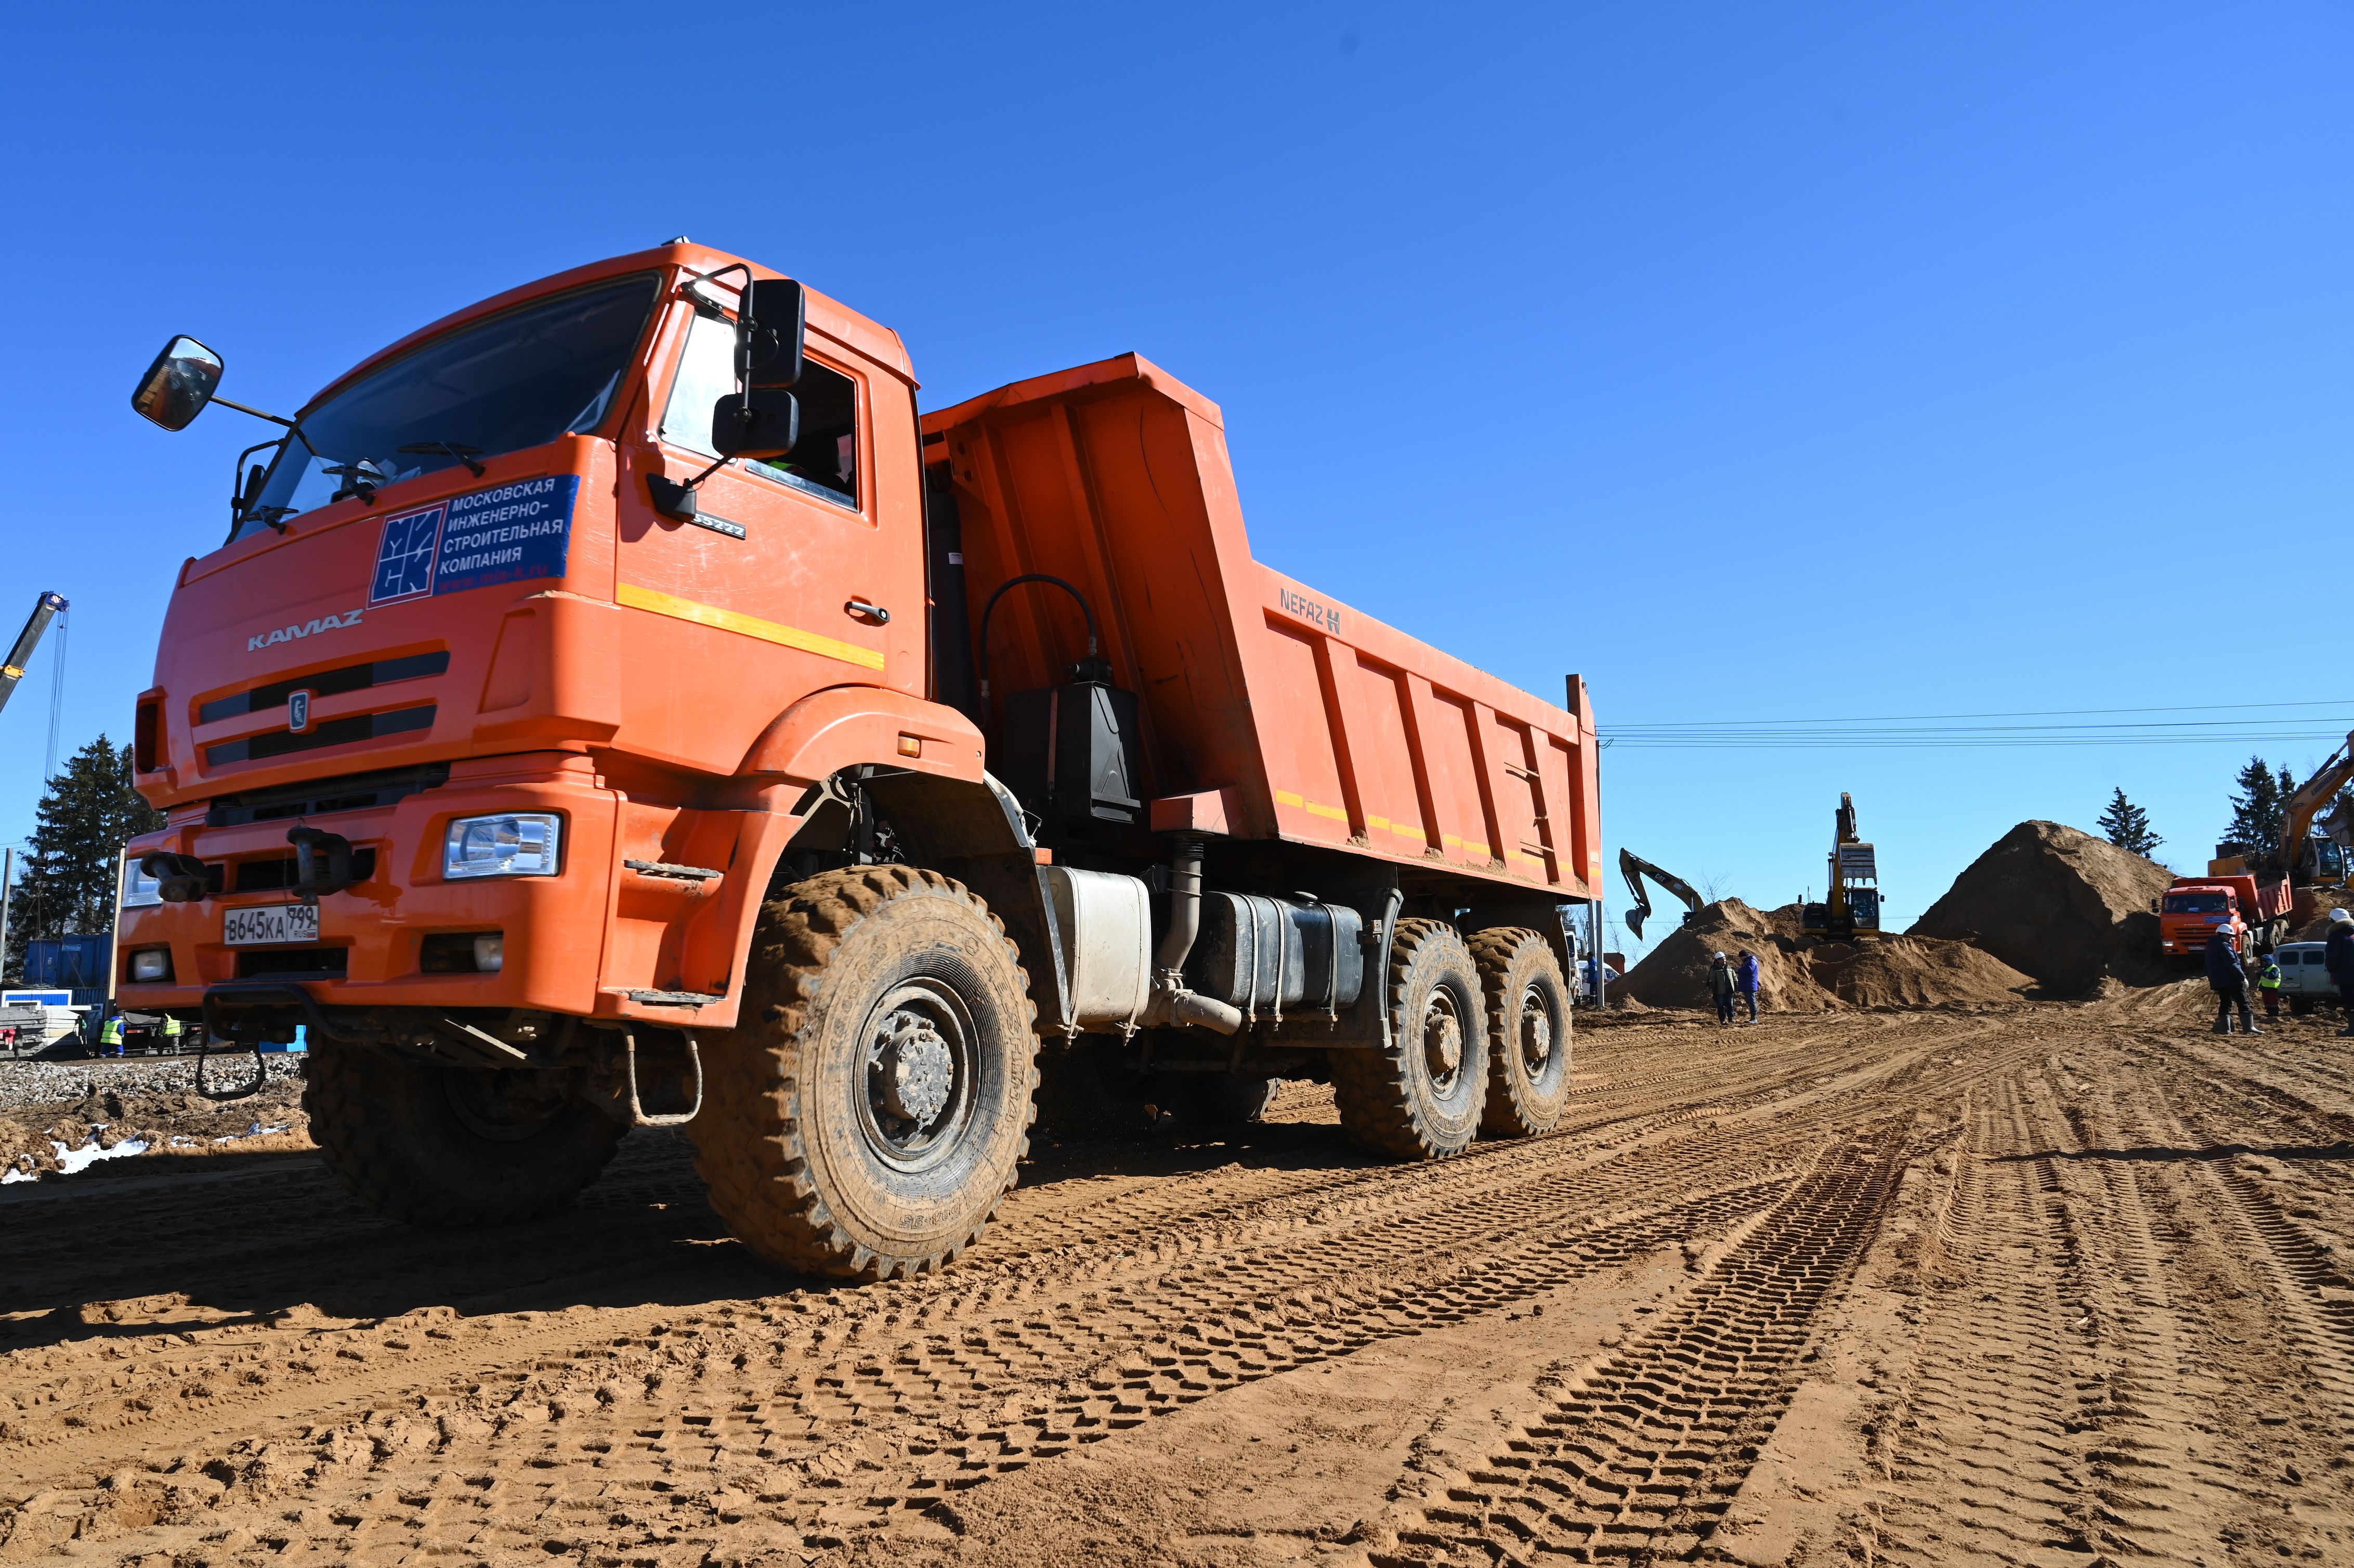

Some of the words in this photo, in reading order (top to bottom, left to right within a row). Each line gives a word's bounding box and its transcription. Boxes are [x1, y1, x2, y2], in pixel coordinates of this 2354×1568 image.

[452, 478, 555, 512] МОСКОВСКАЯ
[448, 501, 550, 532] ИНЖЕНЕРНО-
[443, 519, 564, 553] СТРОИТЕЛЬНАЯ
[439, 546, 522, 575] КОМПАНИЯ
[1280, 587, 1323, 625] NEFAZ
[247, 608, 363, 652] KAMAZ
[1655, 873, 1666, 882] CAT
[287, 907, 314, 930] 799
